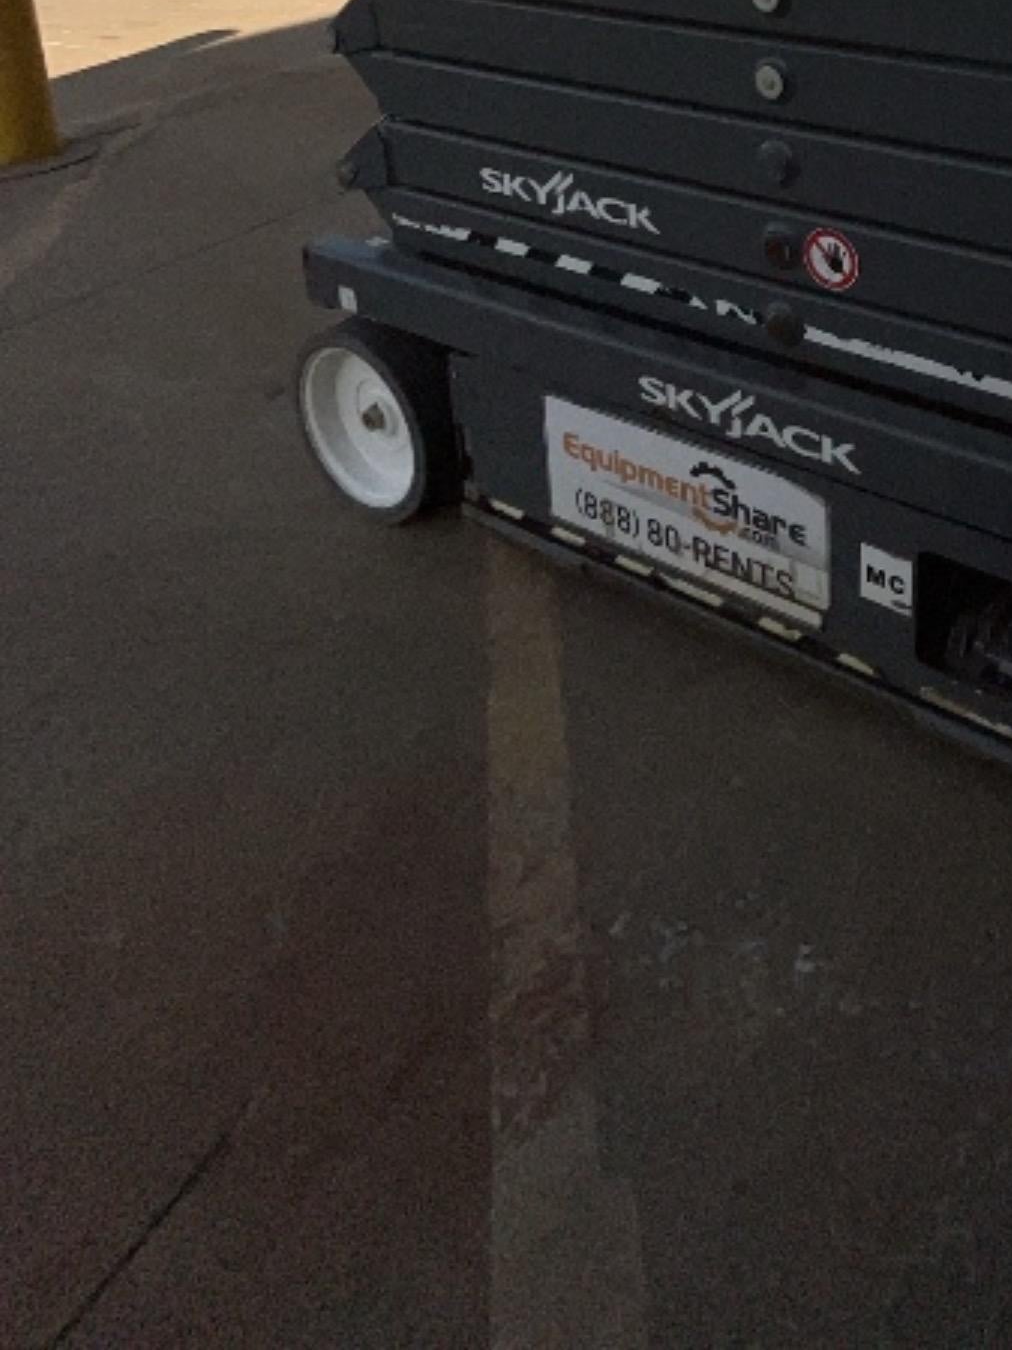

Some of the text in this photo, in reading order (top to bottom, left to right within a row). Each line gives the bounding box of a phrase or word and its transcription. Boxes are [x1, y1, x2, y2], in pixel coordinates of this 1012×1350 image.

[480, 167, 660, 234] SKYJACK
[638, 375, 861, 474] SKYJACK
[562, 432, 807, 547] EquipmentShare
[575, 487, 798, 601] (888) 80-RENTS
